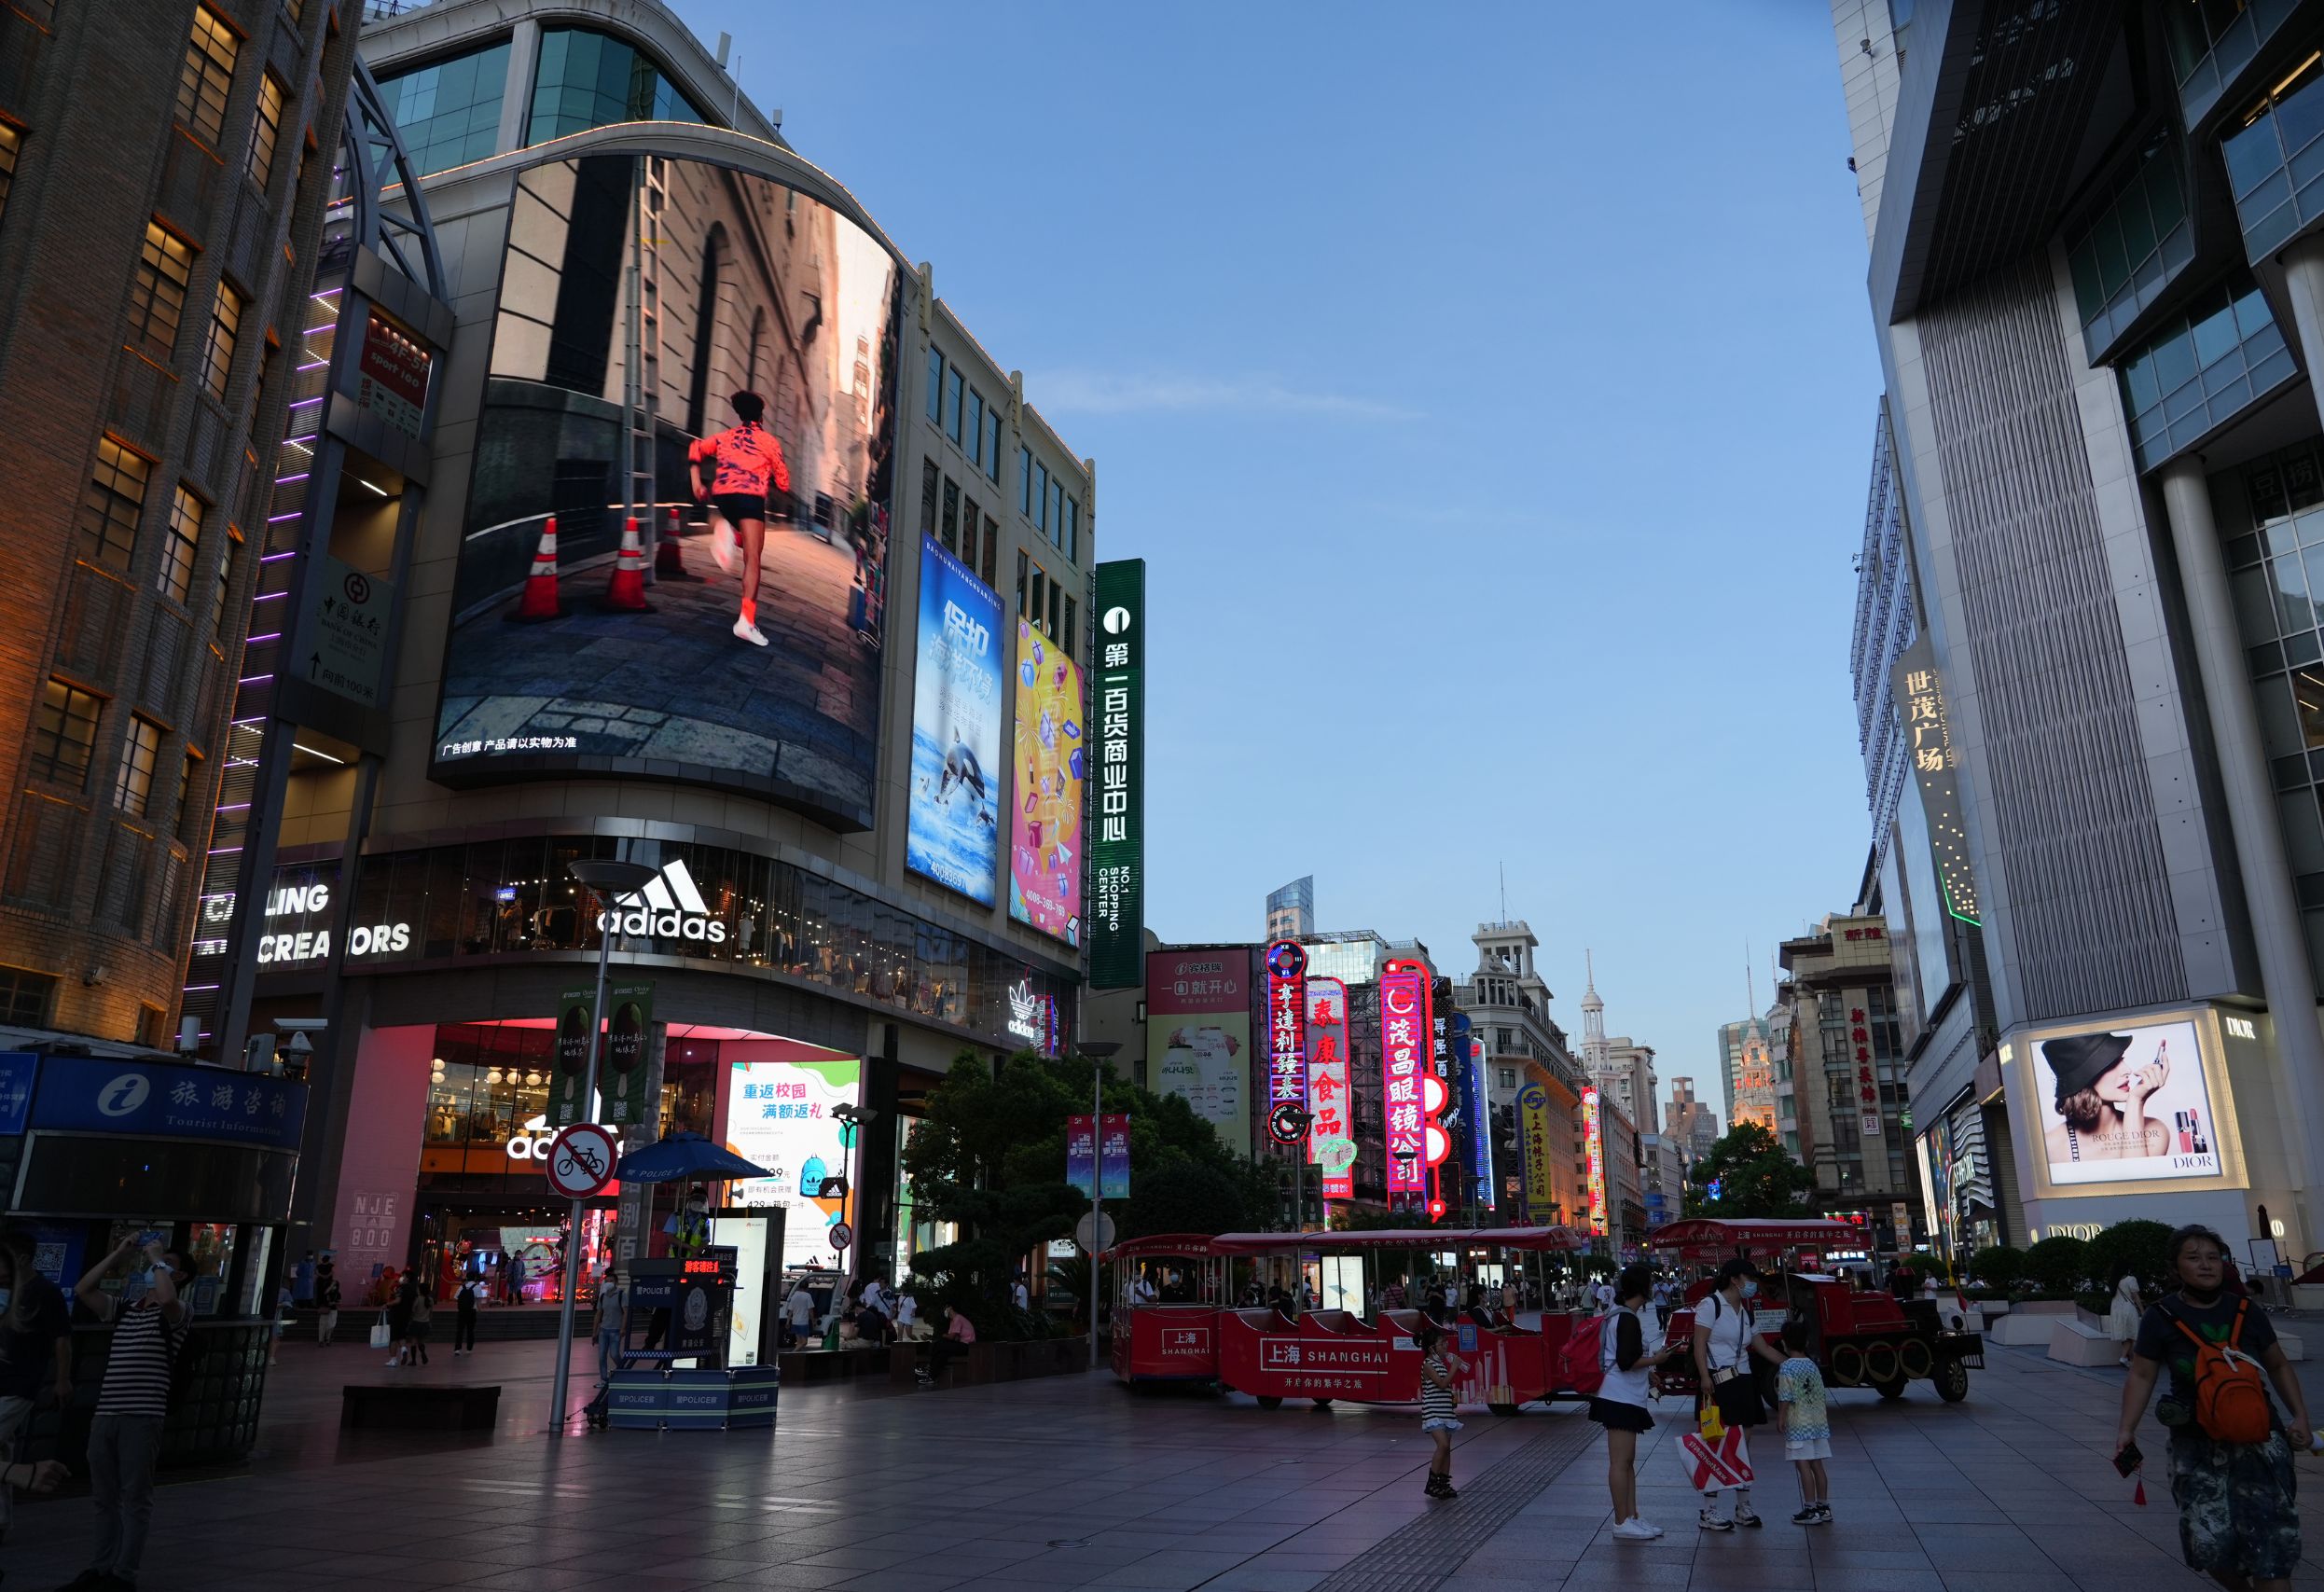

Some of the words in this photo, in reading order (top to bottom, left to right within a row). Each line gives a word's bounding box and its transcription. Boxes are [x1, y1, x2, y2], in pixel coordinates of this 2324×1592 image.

[370, 351, 399, 374] sport
[926, 542, 1001, 611] BAOHUHAIYANGHUANJING
[322, 618, 341, 635] BANK
[324, 597, 380, 636] 中国银行
[943, 599, 989, 658] 保护
[928, 633, 993, 705] 海洋环境
[1904, 671, 1944, 772] 世茂广场
[442, 741, 481, 756] 广告创意
[483, 737, 577, 752] 产品请以实物为准
[1102, 644, 1128, 841] 第一百货商业中心
[1120, 866, 1130, 893] NO.1
[1099, 867, 1108, 918] CENTER
[1109, 866, 1119, 932] SHOPPING
[597, 907, 726, 943] adidas
[256, 923, 410, 963] CREAORS
[2225, 1017, 2255, 1039] DIOR
[1312, 998, 1343, 1136] 泰康食品
[743, 1083, 807, 1099] 重返校园
[1389, 1018, 1420, 1184] 茂昌眼镜公司
[762, 1102, 823, 1119] 满额返礼
[166, 1114, 219, 1130] Tourist
[220, 1119, 282, 1137] Information
[2092, 1131, 2130, 1142] ROUGE
[2131, 1128, 2161, 1140] DIOR
[750, 1154, 780, 1162] 实付金额
[2173, 1155, 2213, 1170] DIOR
[638, 1170, 672, 1178] POLICE
[1736, 1231, 1750, 1239] 上海
[2049, 1224, 2102, 1243] DIOR
[1174, 1332, 1197, 1345] 上海
[1268, 1345, 1301, 1365] 上海
[1307, 1351, 1389, 1364] SHANGHAI
[1284, 1377, 1363, 1389] 开启你的繁华之旅
